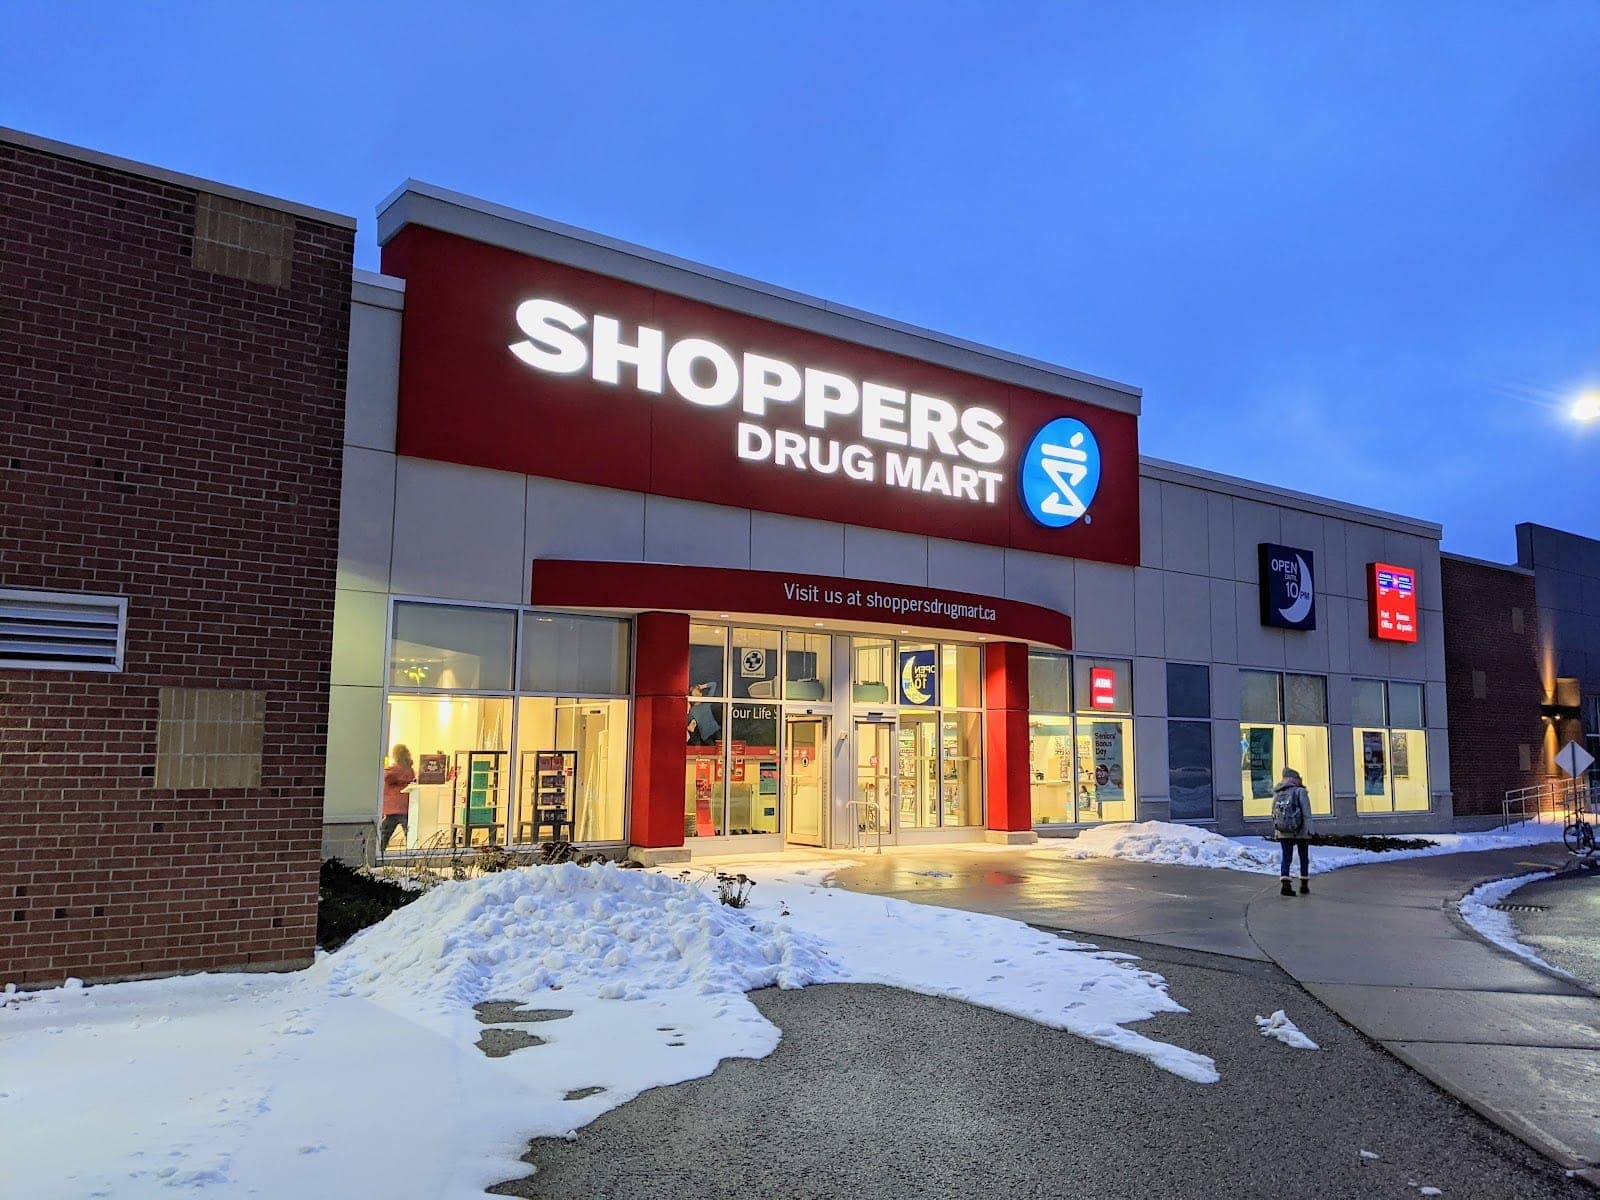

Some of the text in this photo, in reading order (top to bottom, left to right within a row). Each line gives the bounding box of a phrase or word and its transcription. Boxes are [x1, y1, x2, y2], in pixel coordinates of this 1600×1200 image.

[508, 299, 1005, 464] SHOPPERS
[737, 422, 1003, 504] DRUG MART
[1271, 558, 1298, 575] OPEN
[784, 583, 996, 621] Visit us at shoppersdrugmart.ca
[1285, 581, 1310, 600] 10 PM
[731, 706, 751, 720] our
[753, 706, 772, 720] Life
